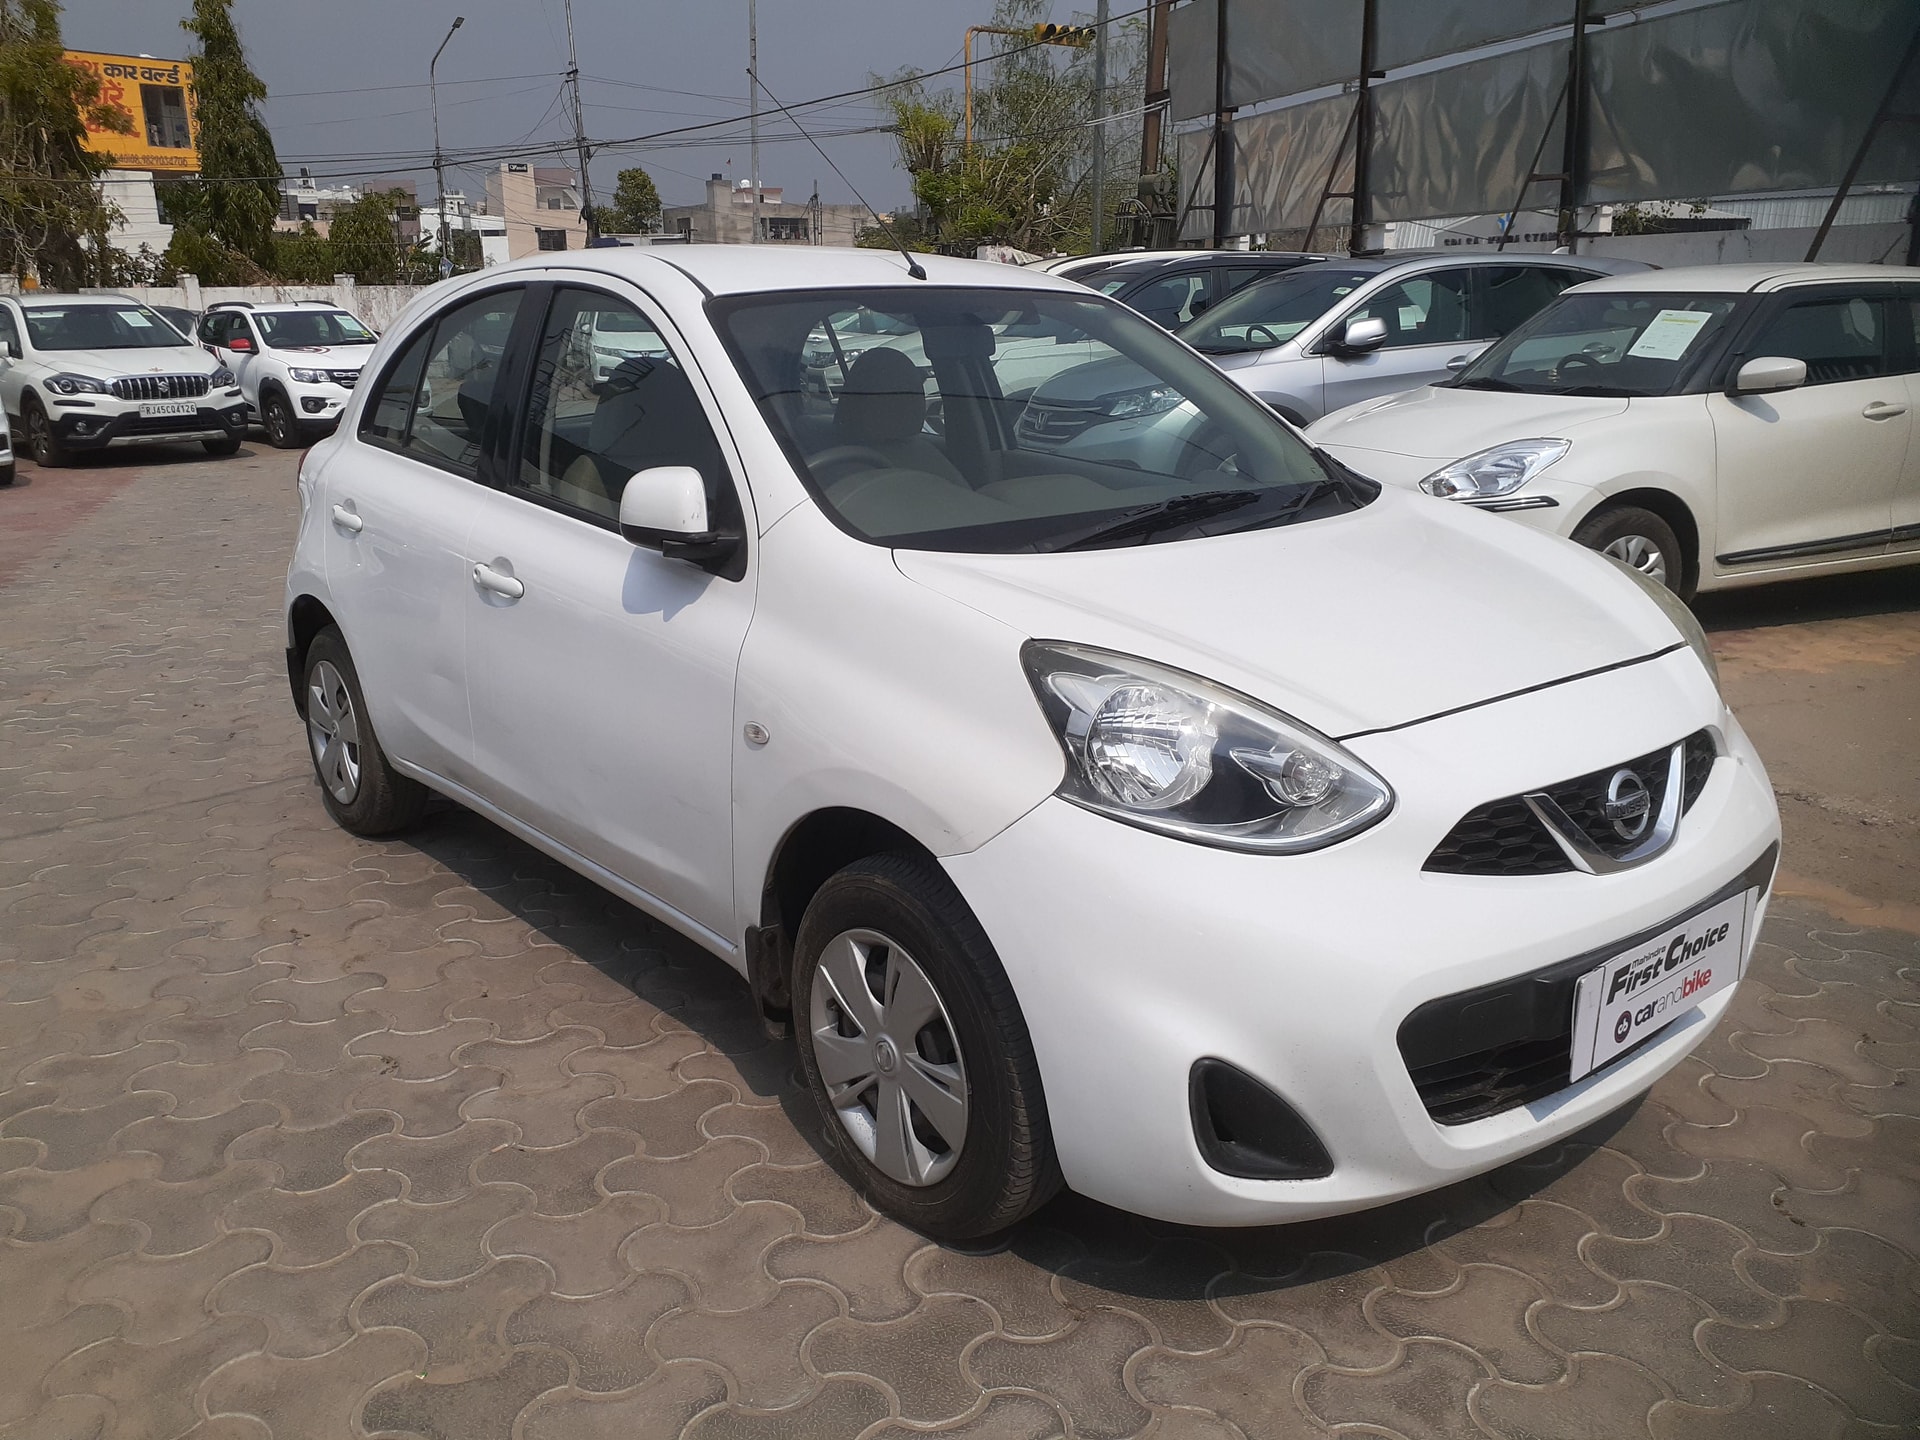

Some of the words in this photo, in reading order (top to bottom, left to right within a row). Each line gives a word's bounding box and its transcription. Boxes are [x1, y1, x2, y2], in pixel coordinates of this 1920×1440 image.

[103, 63, 138, 80] कार
[146, 404, 196, 415] RJ45CQ4126
[1616, 795, 1649, 817] NISSA
[1634, 968, 1712, 1027] carandbike
